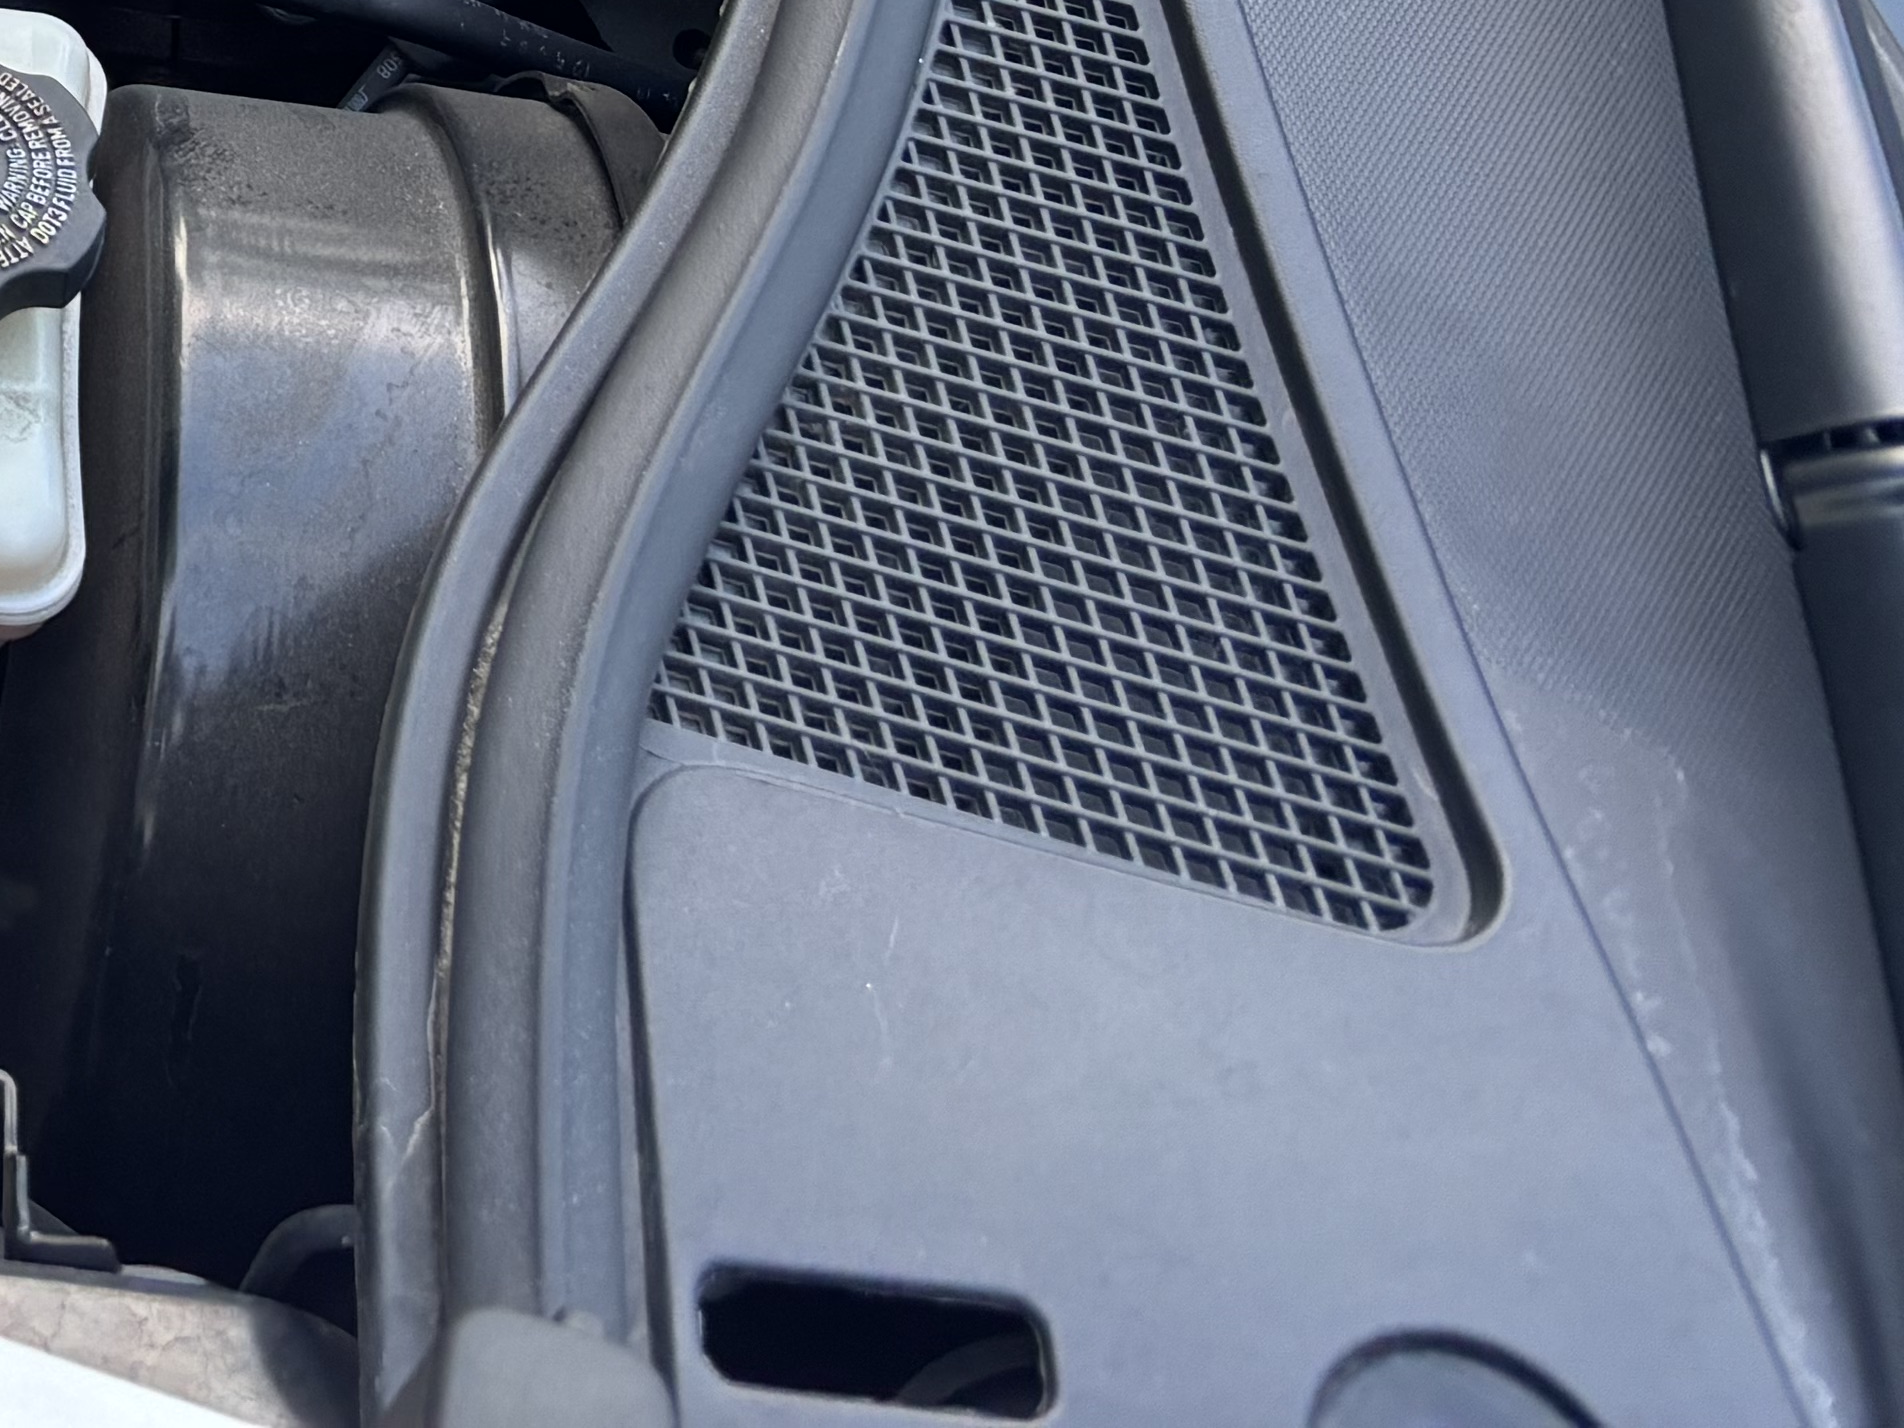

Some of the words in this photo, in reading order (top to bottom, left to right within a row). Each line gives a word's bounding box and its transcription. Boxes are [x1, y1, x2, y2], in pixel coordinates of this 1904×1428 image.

[41, 115, 59, 125] A
[46, 127, 76, 166] FROM
[9, 202, 40, 230] CAP
[26, 151, 53, 206] BEFORE
[52, 166, 78, 212] FLUID
